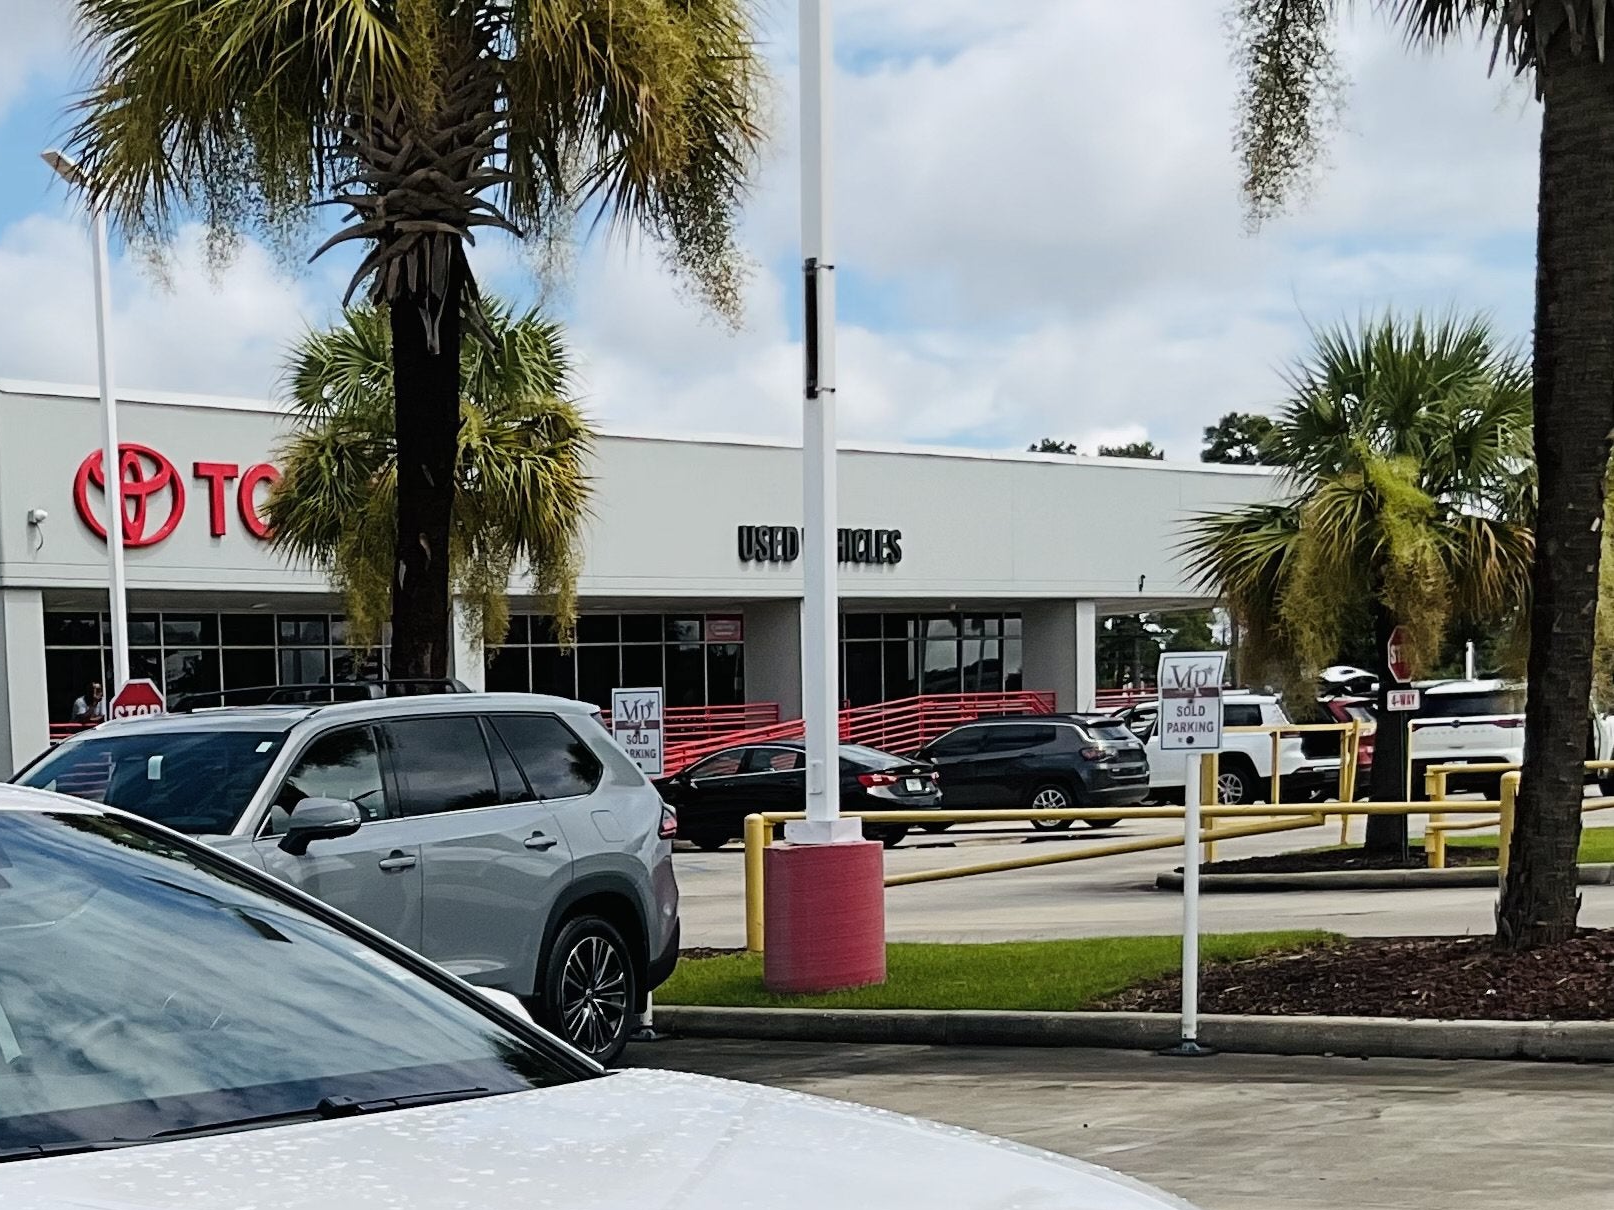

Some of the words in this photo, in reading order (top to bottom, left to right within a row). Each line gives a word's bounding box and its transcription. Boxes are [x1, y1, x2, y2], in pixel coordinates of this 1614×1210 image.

[738, 525, 800, 562] USED
[801, 527, 903, 564] HICLES
[114, 704, 162, 718] STOP
[1176, 705, 1206, 717] SOLD
[1166, 721, 1215, 734] PARKING
[626, 733, 650, 745] SOLD
[625, 748, 658, 759] RKING
